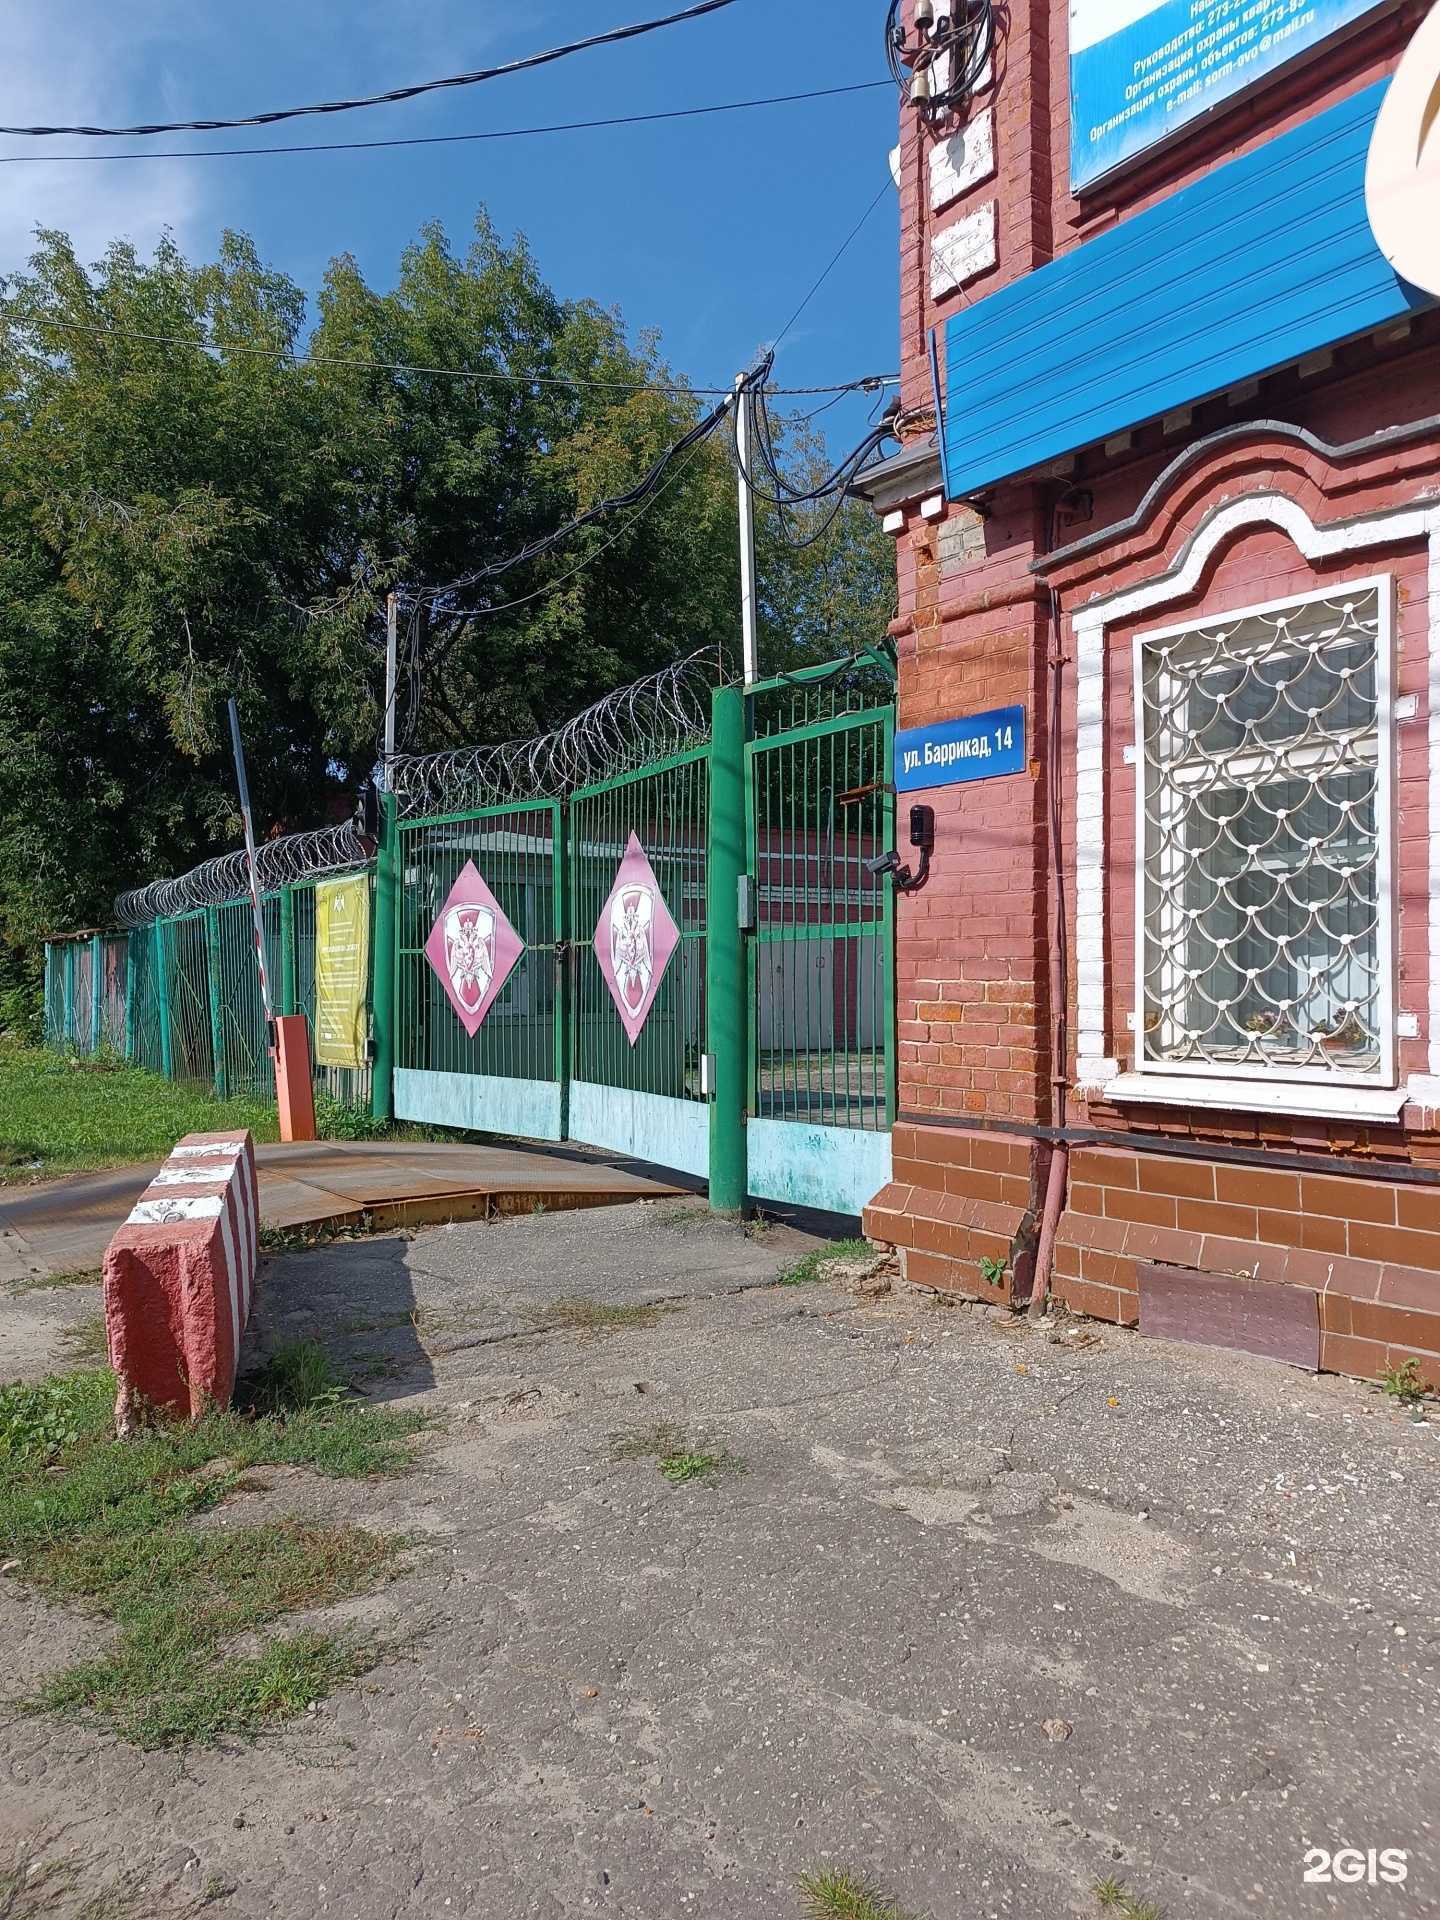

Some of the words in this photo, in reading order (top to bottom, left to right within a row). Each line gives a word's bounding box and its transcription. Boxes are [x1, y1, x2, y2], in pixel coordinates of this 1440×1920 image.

[1125, 45, 1194, 100] Организация
[1196, 16, 1239, 53] охраны
[1133, 20, 1205, 77] Руководство:
[1090, 92, 1155, 143] Организация
[1158, 63, 1198, 98] охраны
[1201, 24, 1258, 69] объектов:
[1166, 79, 1202, 112] e-mail:
[904, 750, 921, 773] ул.
[924, 736, 992, 767] Баррикад,
[995, 726, 1013, 751] 14
